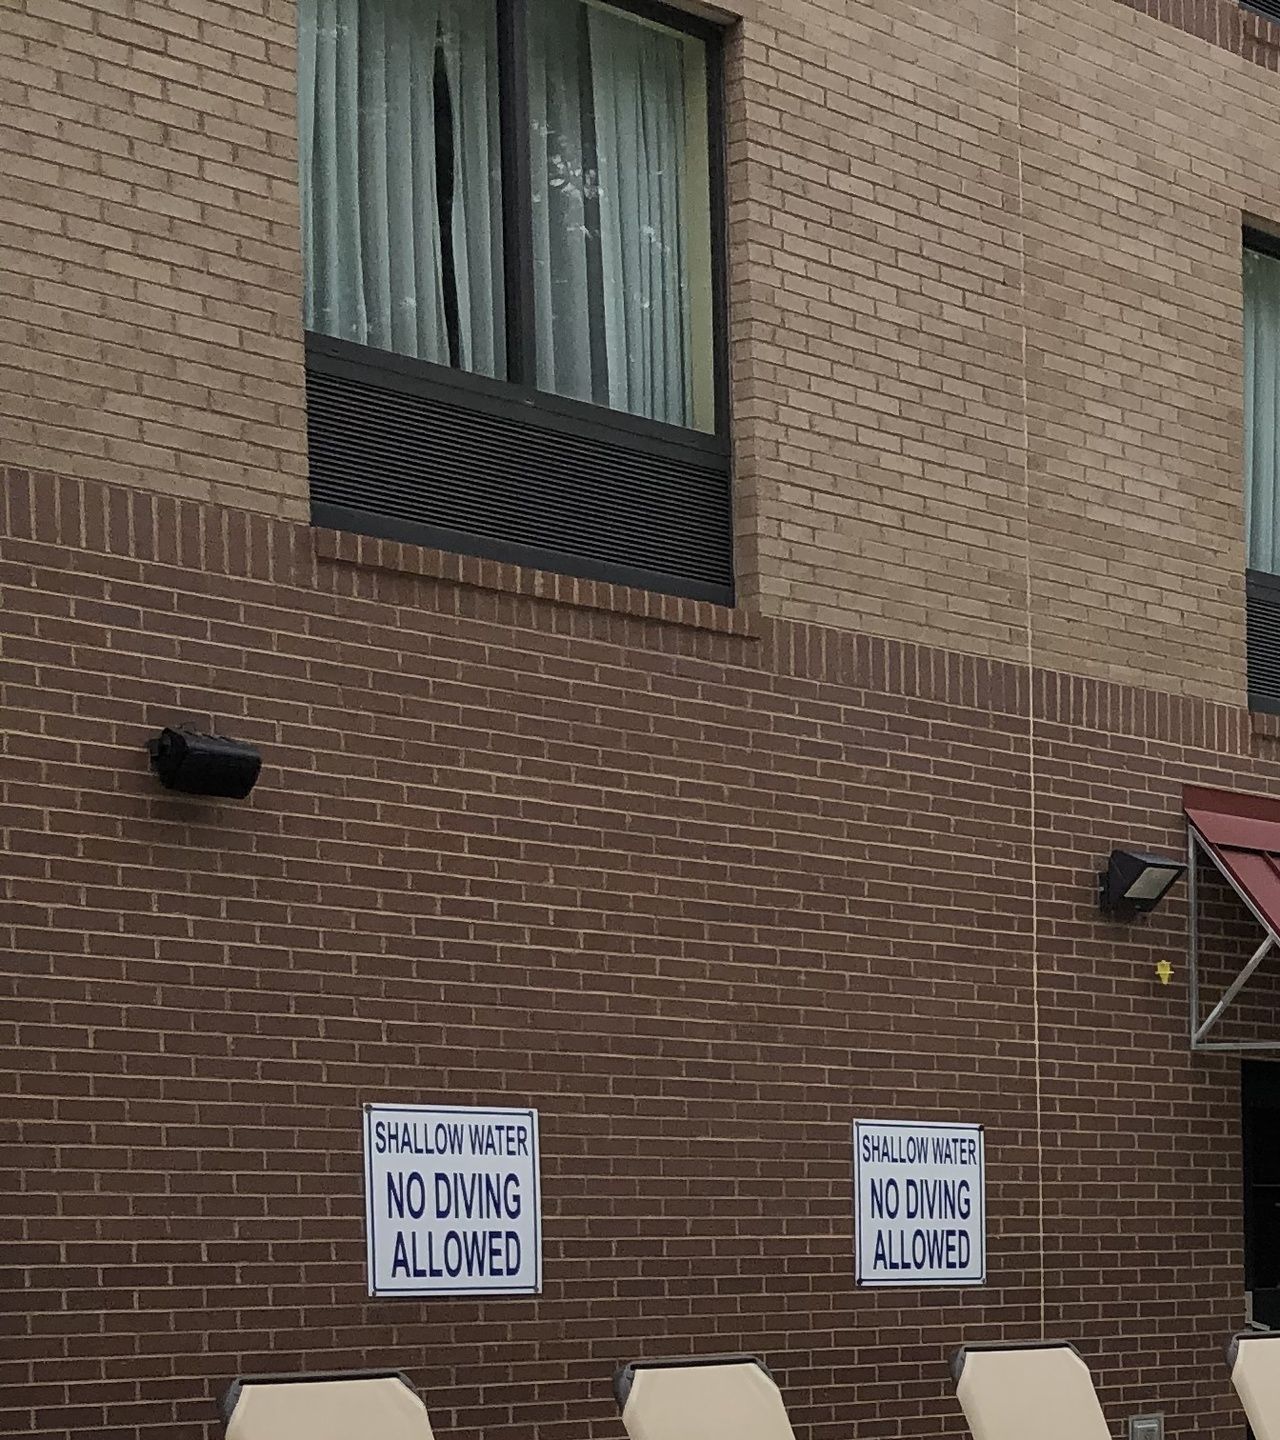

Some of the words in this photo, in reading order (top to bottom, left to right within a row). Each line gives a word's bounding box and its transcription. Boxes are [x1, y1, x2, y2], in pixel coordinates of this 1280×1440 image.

[375, 1121, 464, 1155] SHALLOW
[469, 1124, 528, 1156] WATER
[862, 1134, 929, 1164] SHALLOW
[932, 1137, 977, 1165] WATER
[387, 1171, 426, 1220] NO
[434, 1172, 521, 1220] DIVING
[870, 1178, 900, 1219] NO
[906, 1179, 971, 1220] DIVING
[391, 1230, 521, 1278] ALLOWED
[873, 1229, 970, 1270] ALLOWED
